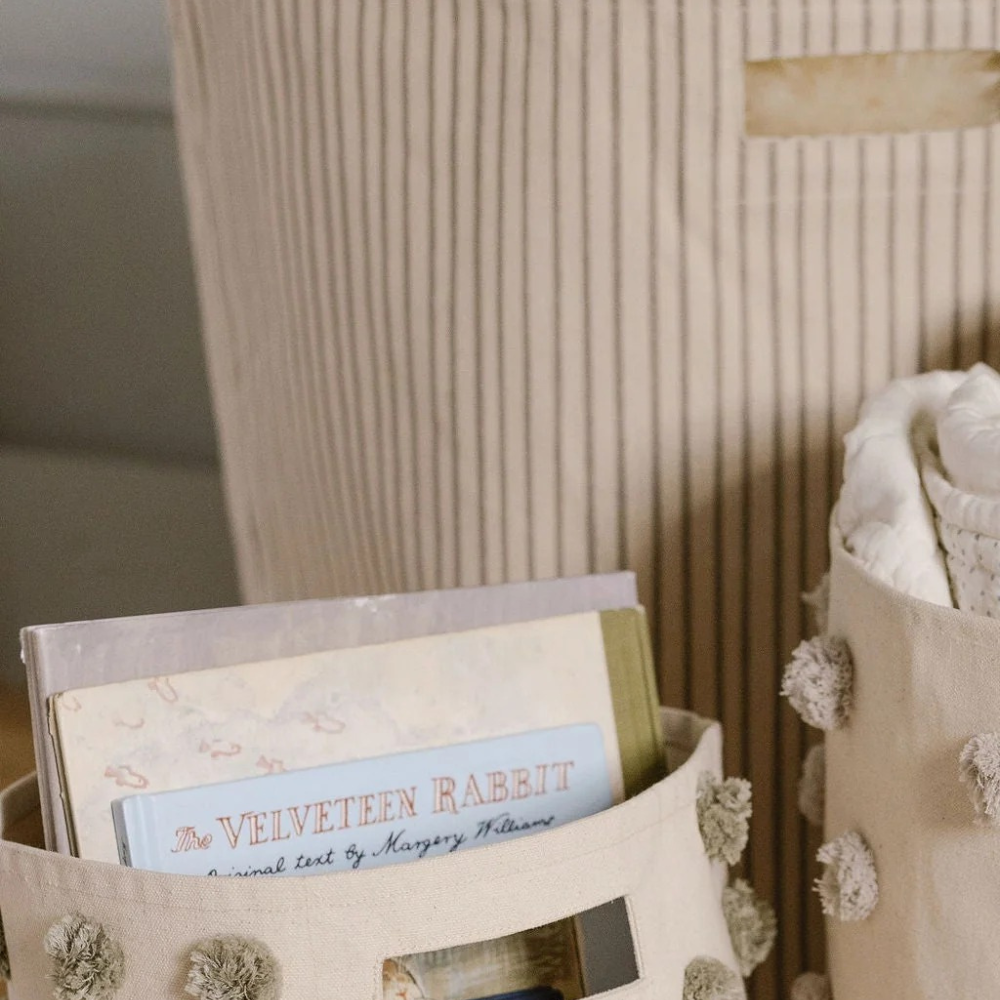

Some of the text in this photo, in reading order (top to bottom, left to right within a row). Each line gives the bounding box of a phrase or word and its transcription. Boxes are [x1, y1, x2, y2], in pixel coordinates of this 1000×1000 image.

[171, 760, 575, 853] The VELVETEEN RABBIT
[294, 847, 335, 870] text
[344, 843, 366, 869] by
[372, 829, 467, 859] Margery
[474, 812, 555, 839] Williams
